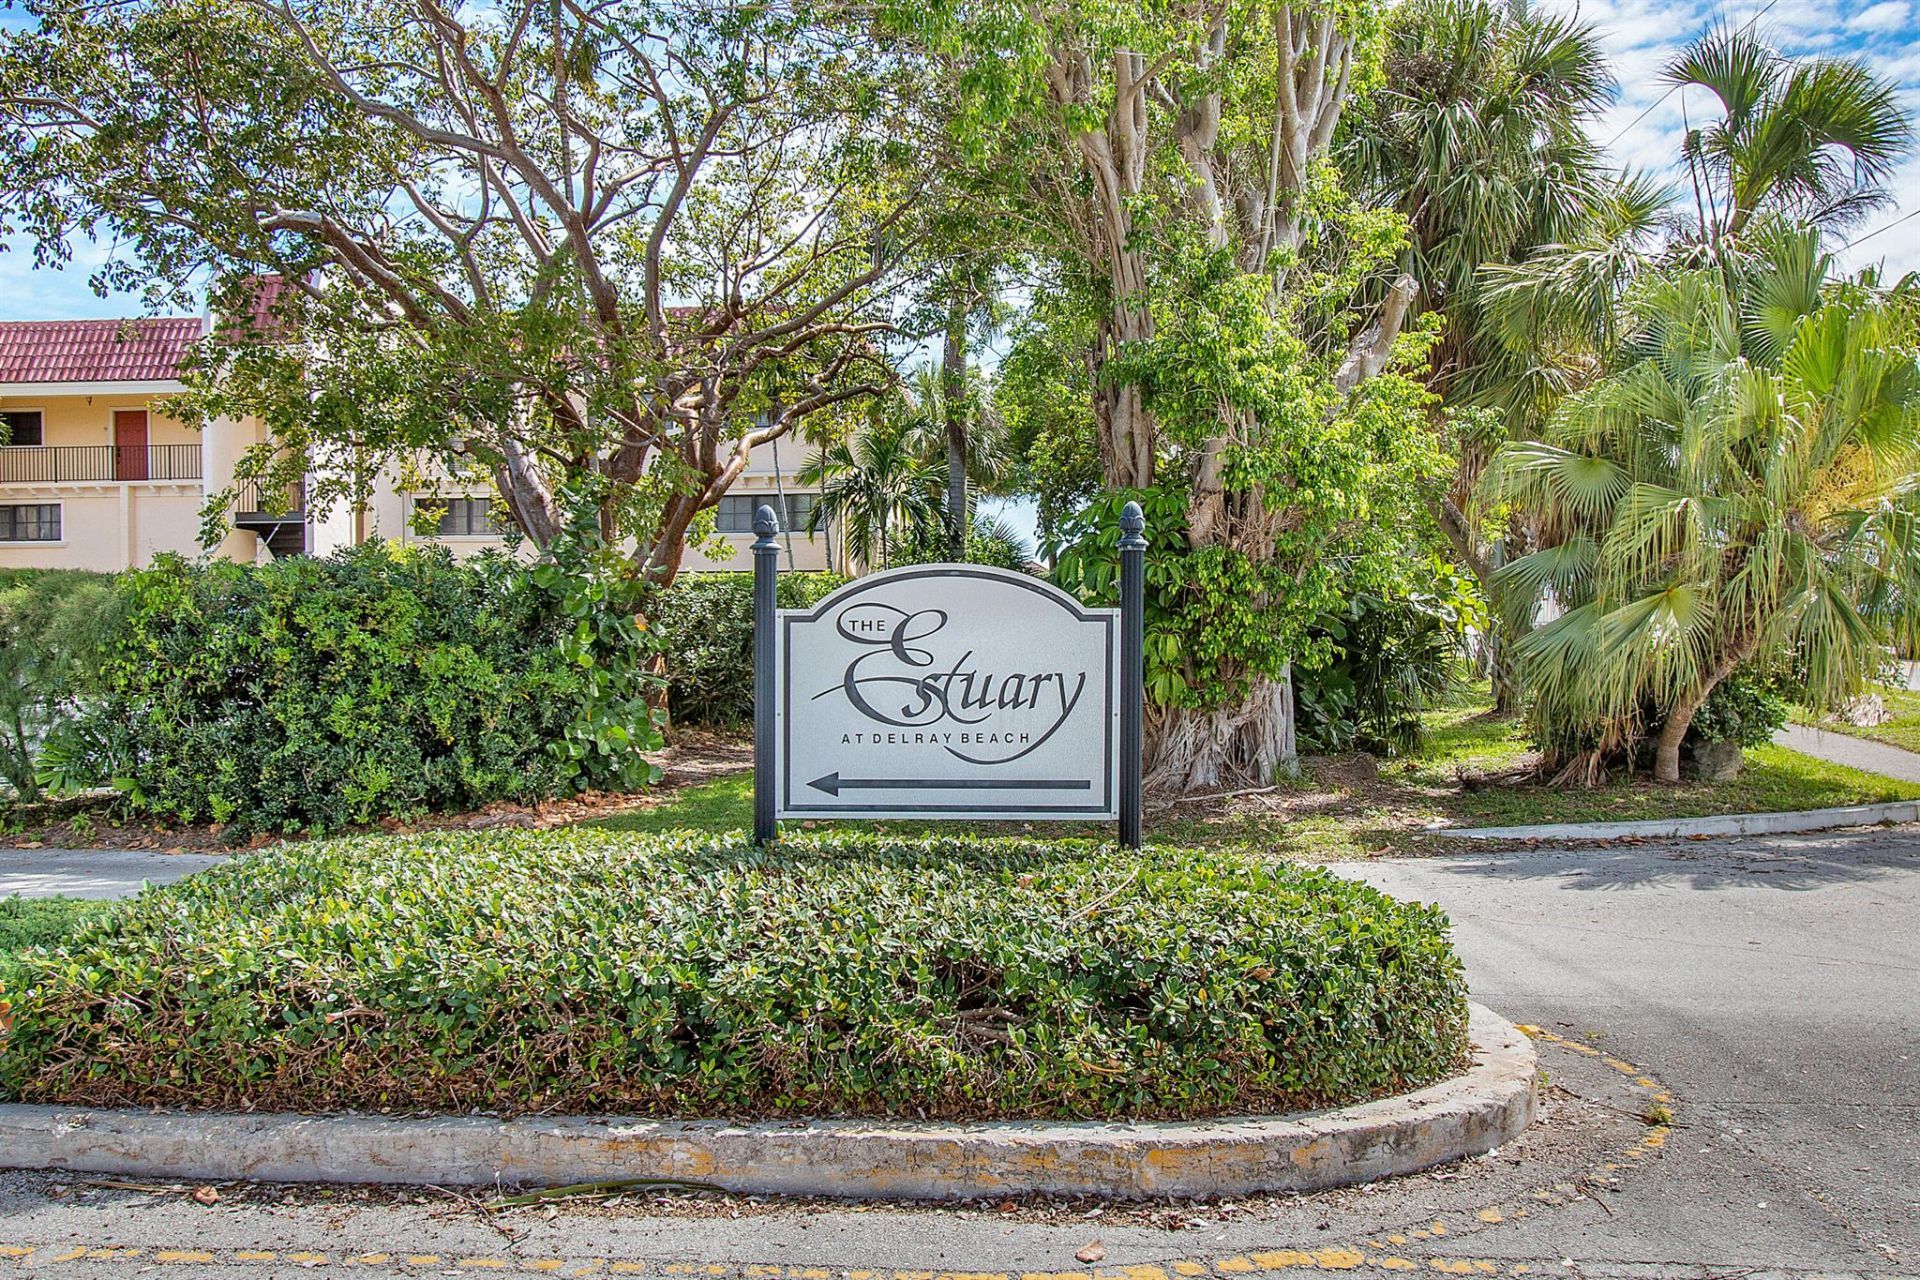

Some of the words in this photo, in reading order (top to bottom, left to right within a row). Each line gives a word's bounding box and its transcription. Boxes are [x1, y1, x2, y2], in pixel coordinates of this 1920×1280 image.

[848, 619, 886, 632] THE
[811, 603, 1086, 765] Estuary
[841, 733, 865, 745] AT
[872, 733, 953, 745] DELRAY
[960, 732, 1030, 744] BEACH
